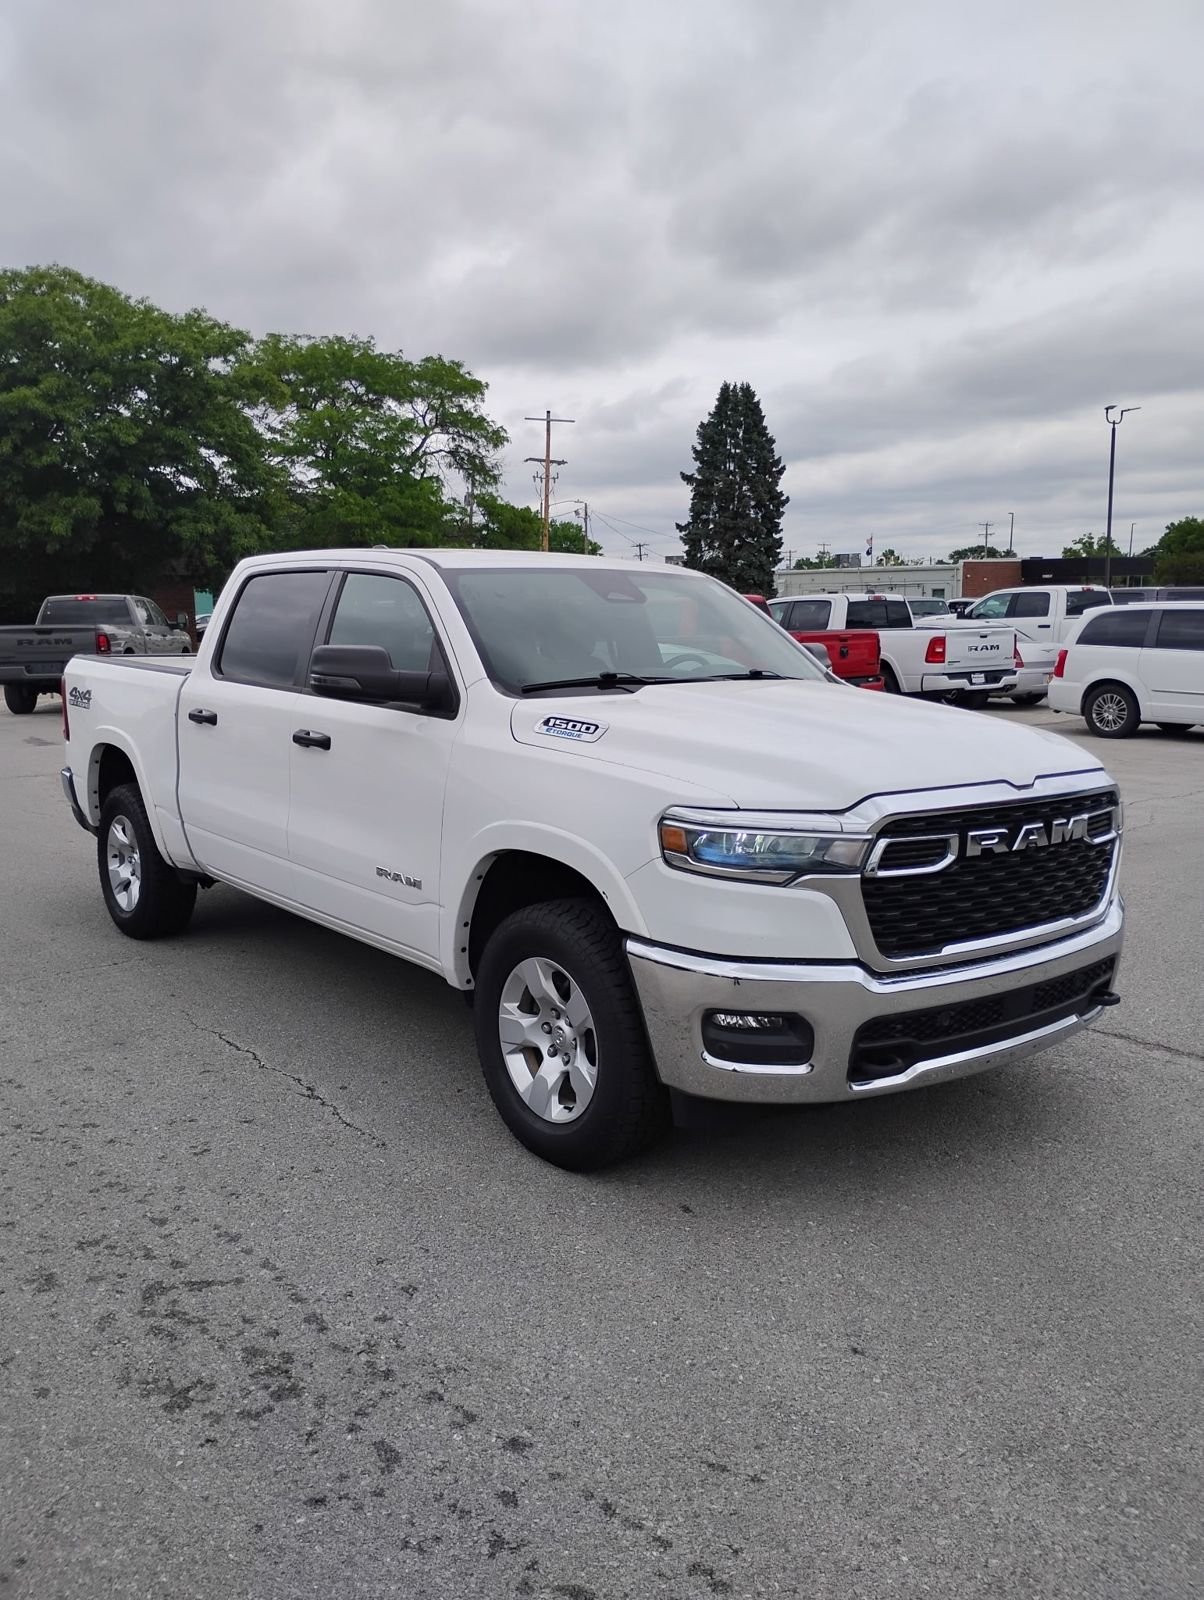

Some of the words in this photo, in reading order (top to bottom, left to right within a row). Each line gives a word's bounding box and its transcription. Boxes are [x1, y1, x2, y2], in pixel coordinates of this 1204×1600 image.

[17, 638, 72, 646] RAM
[968, 644, 1000, 652] RAM
[69, 686, 92, 702] 4x4
[548, 718, 597, 733] 1500
[966, 814, 1088, 857] RAM
[376, 866, 422, 890] RAM
